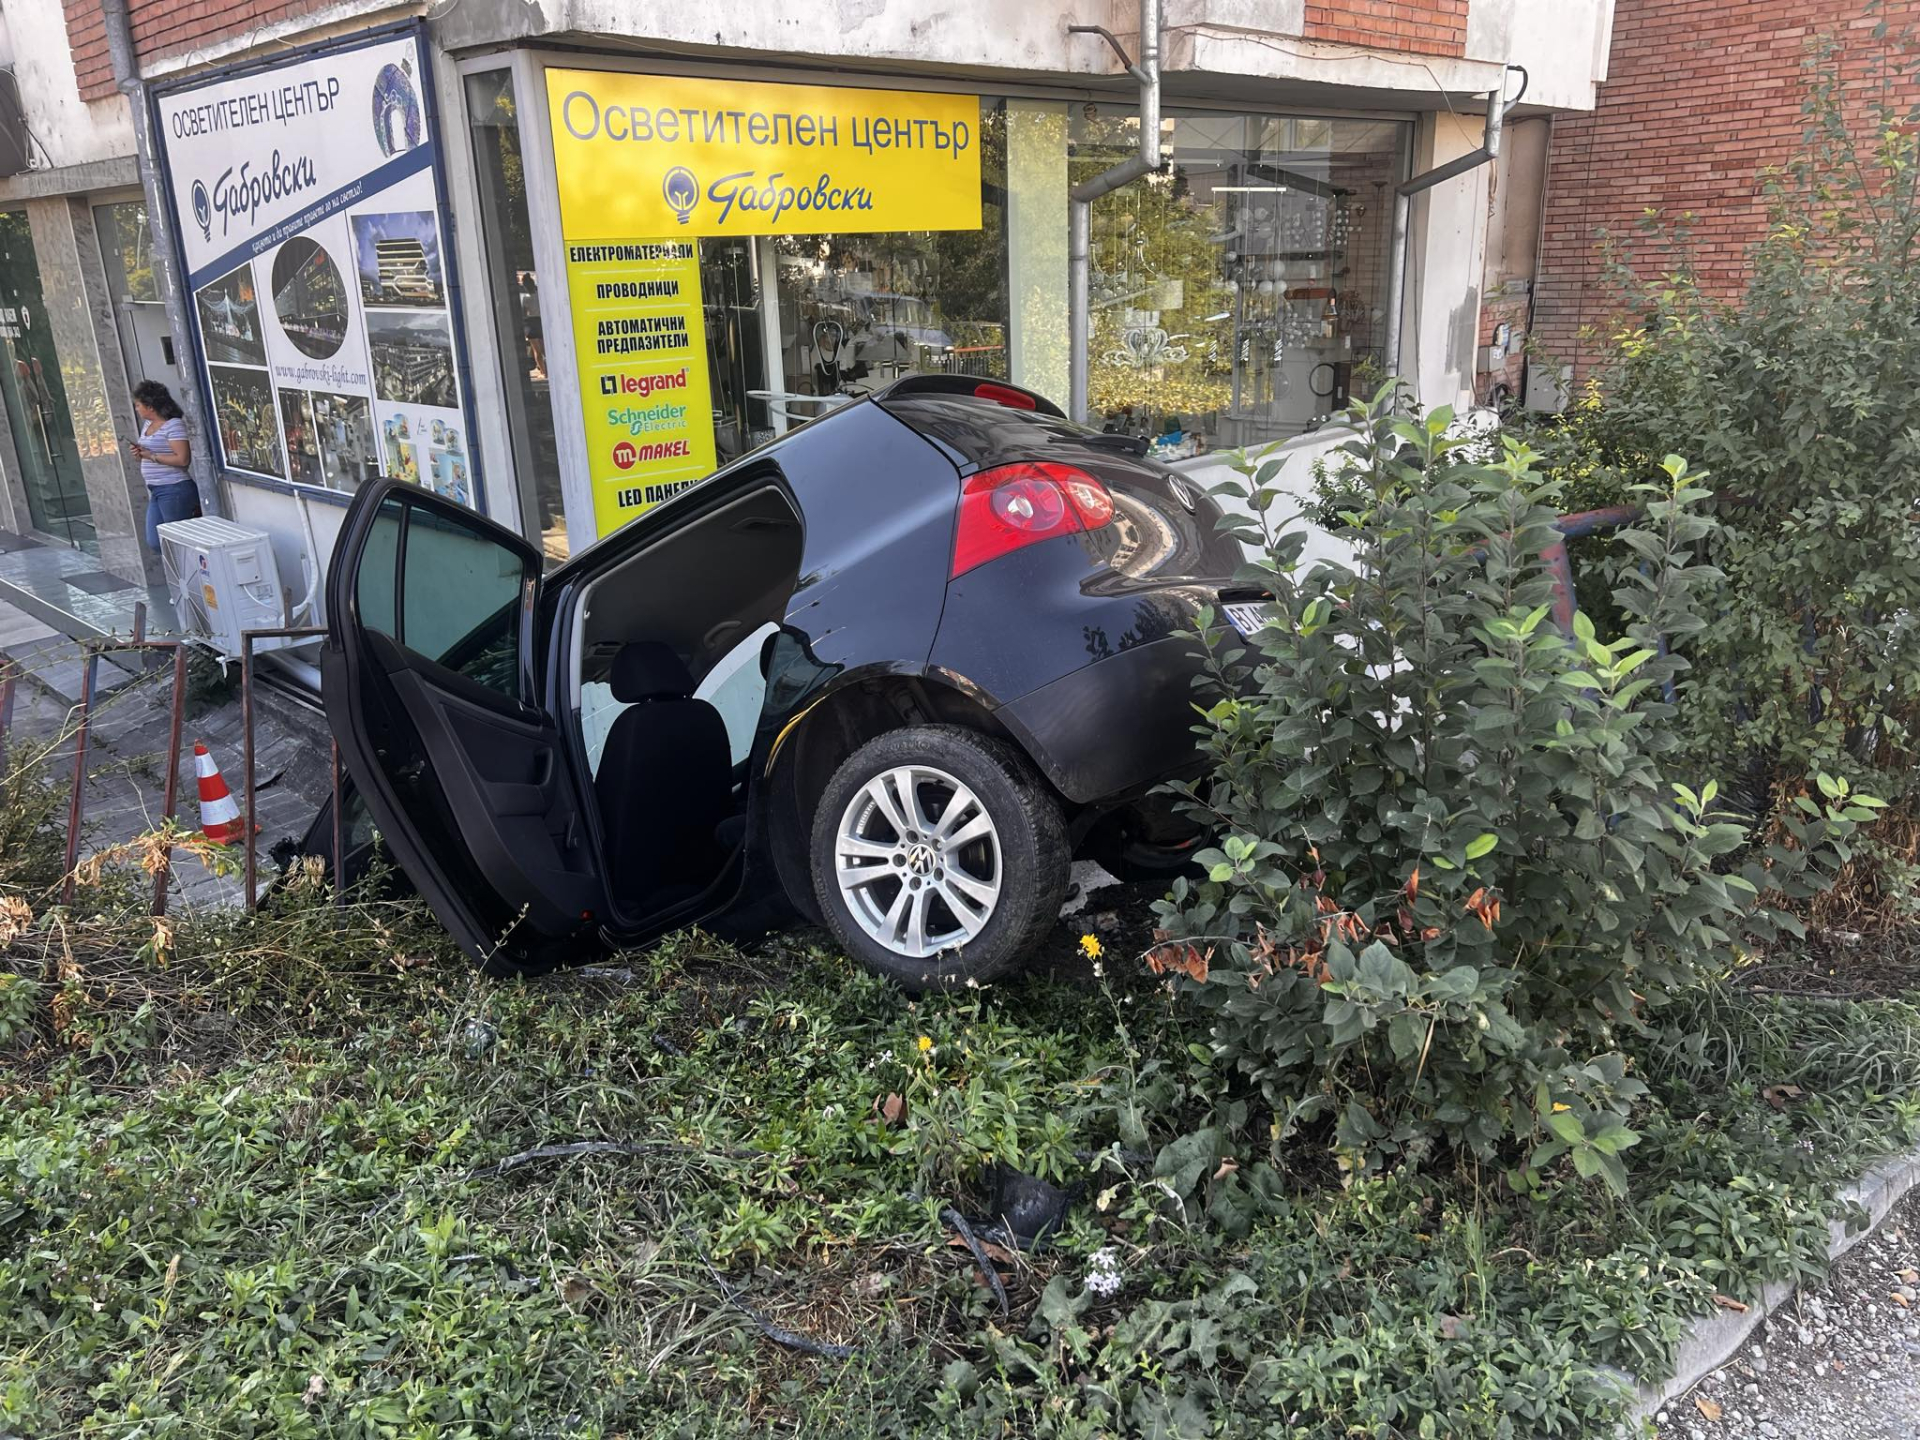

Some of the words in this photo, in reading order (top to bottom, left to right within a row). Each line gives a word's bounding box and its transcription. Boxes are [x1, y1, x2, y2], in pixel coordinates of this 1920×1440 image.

[172, 91, 269, 139] ОСВЕТИТЕЛЕН
[273, 77, 340, 126] ЦЕНТЪР
[562, 90, 839, 148] Осветителен
[851, 114, 970, 160] център
[213, 149, 317, 236] Габровски
[707, 170, 874, 225] Габровски
[570, 244, 693, 262] ЕЛЕКТРОМАТЕРИАЛИ
[596, 280, 679, 299] ПРОВОДНИЦИ
[598, 316, 686, 336] АВТОМАТИЧНИ
[597, 333, 689, 354] ПРЕДПАЗИТЕЛИ
[275, 362, 367, 388] www.gabrovski-light.com
[621, 368, 686, 398] legrand
[608, 404, 686, 425] Schneider
[644, 420, 686, 432] Electric
[639, 441, 690, 462] MAKEL
[618, 488, 642, 507] LED
[645, 479, 699, 503] ПАНЕ
